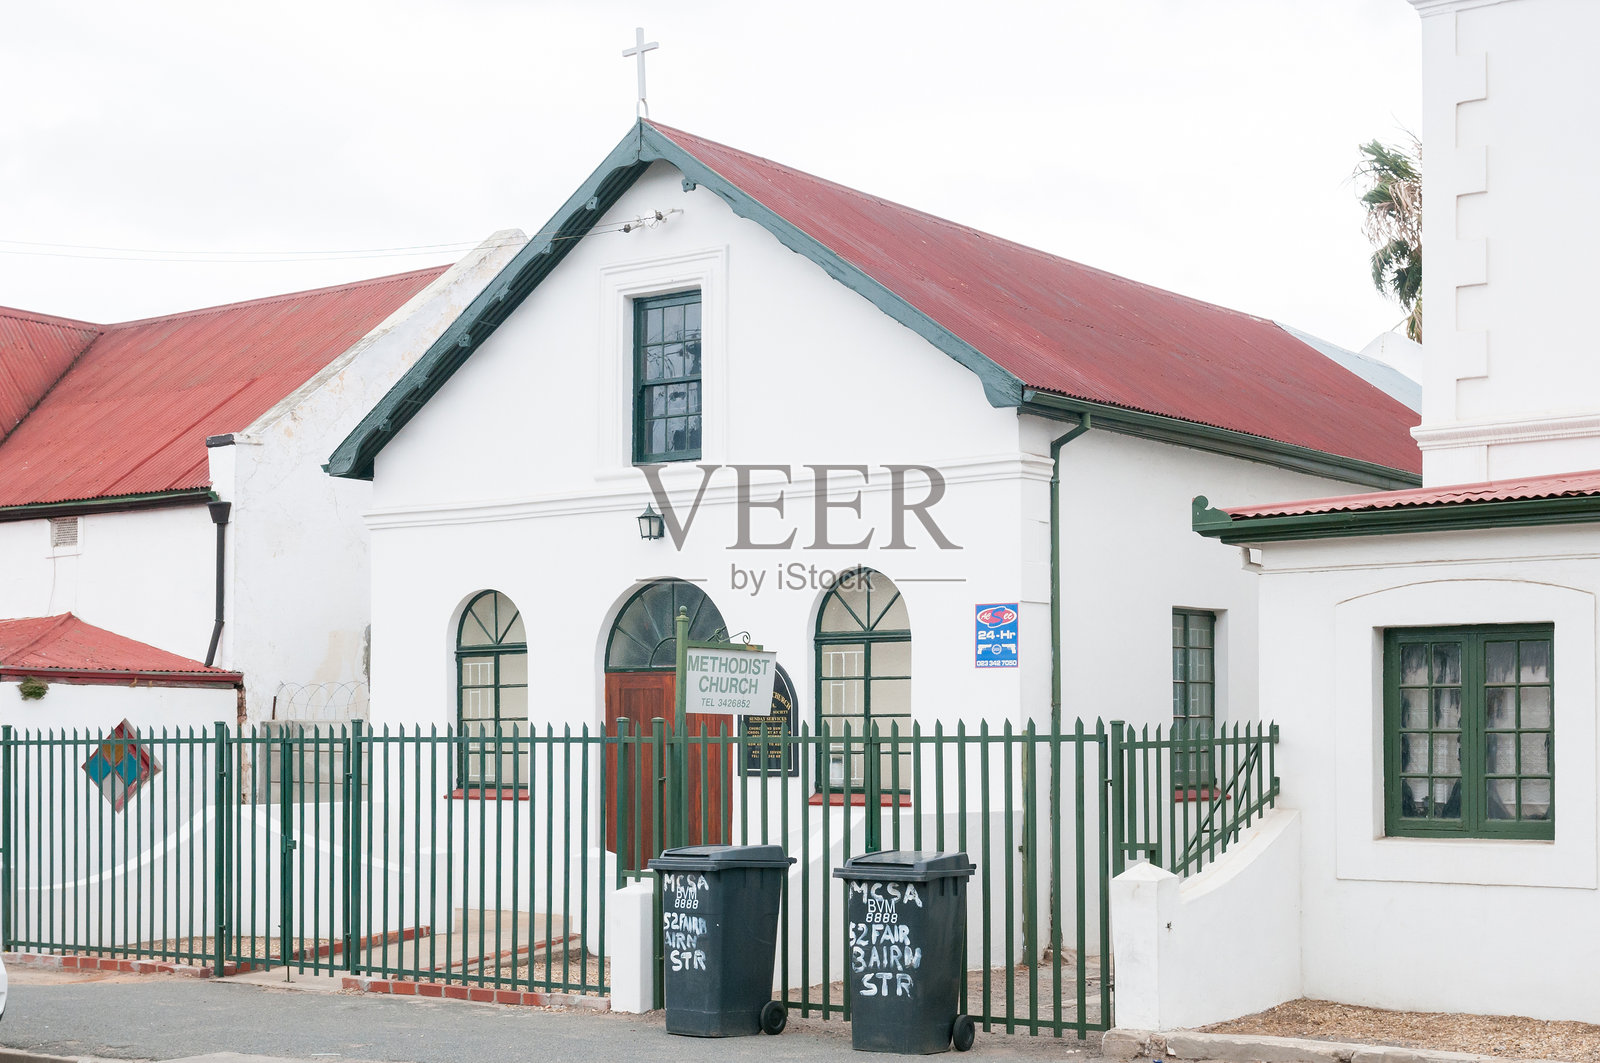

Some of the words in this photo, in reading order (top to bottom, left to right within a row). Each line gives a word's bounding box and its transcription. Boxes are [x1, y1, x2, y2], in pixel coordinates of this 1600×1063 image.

[687, 655, 770, 675] METHODIST
[699, 675, 759, 695] CHURCH
[701, 698, 715, 707] TEL
[718, 698, 751, 709] 3426852
[664, 873, 709, 893] MCSA
[676, 885, 697, 900] BVM
[674, 898, 699, 909] 8888
[849, 881, 923, 908] MCSA
[868, 899, 896, 913] BVM
[866, 913, 898, 924] 8888
[670, 949, 706, 972] STR
[859, 972, 913, 998] STR
